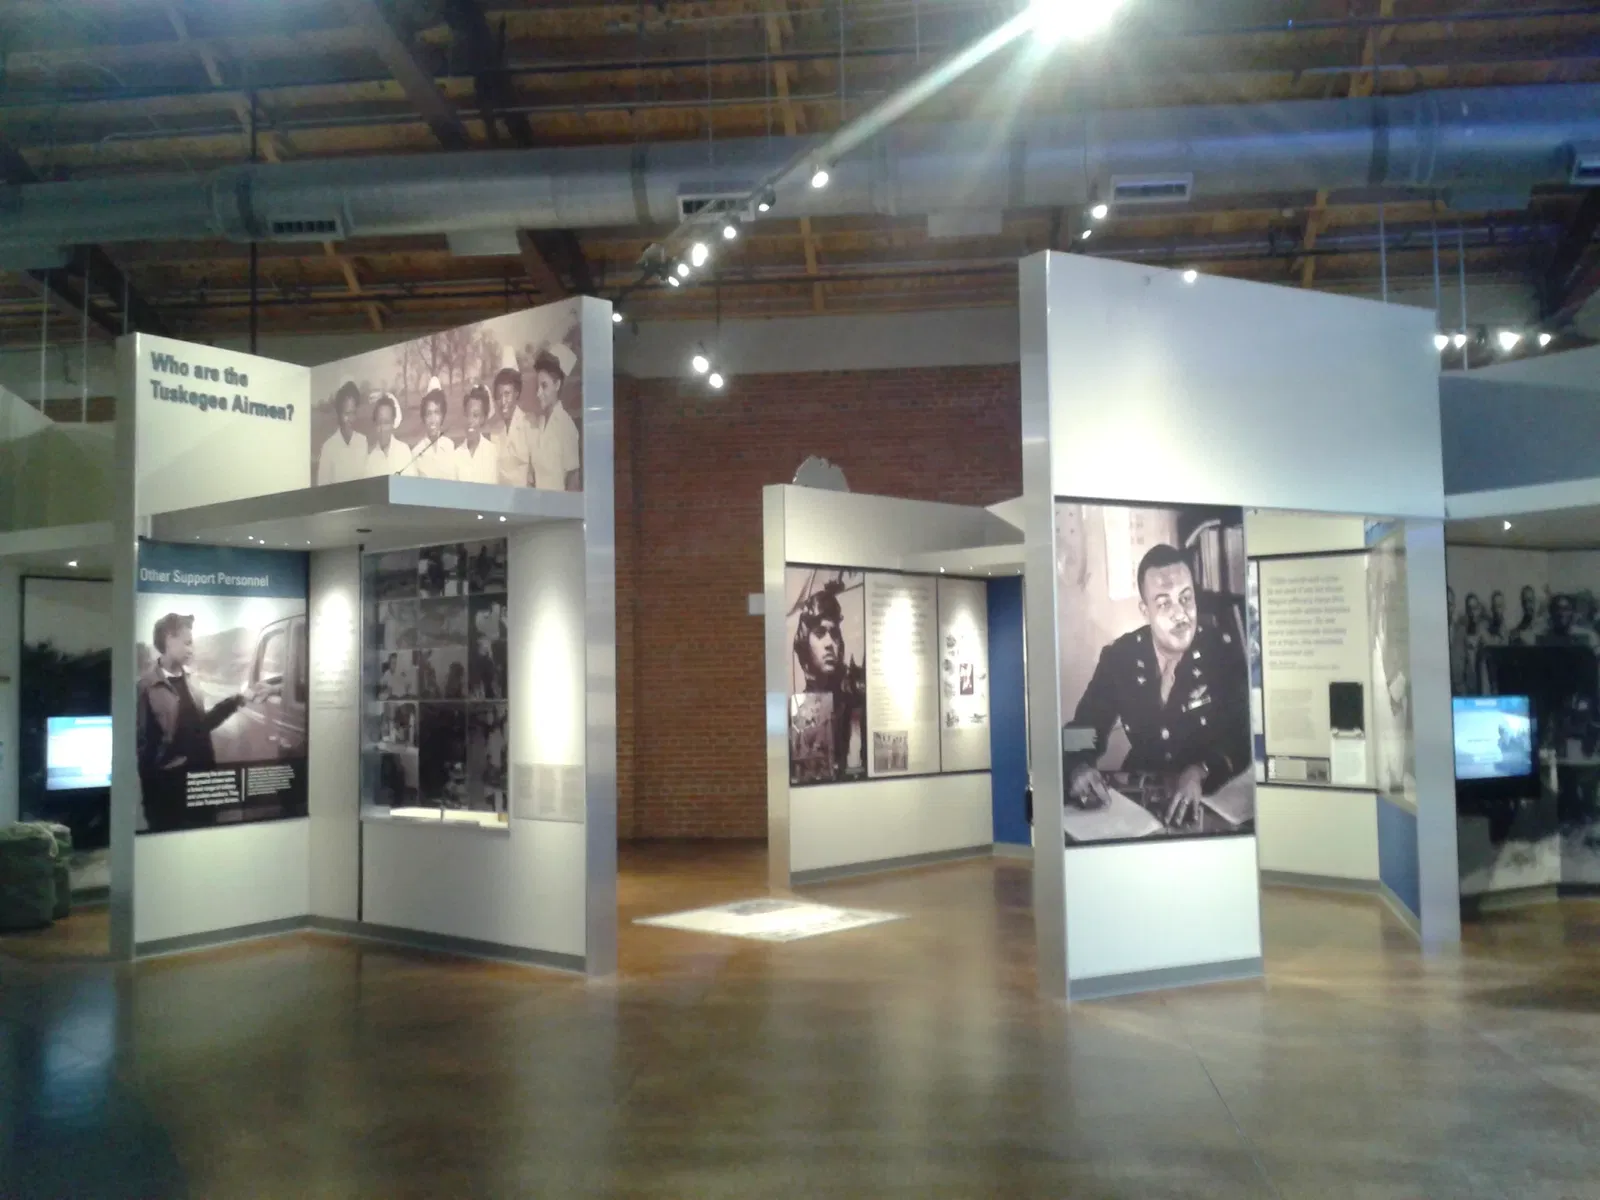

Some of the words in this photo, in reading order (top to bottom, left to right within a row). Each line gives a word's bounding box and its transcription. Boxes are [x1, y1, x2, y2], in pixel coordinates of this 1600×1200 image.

[151, 351, 189, 376] Who
[194, 364, 219, 382] are
[224, 367, 248, 387] the
[150, 379, 228, 412] Tuskegee
[232, 394, 294, 421] Airmen?
[140, 568, 171, 582] Other
[173, 569, 216, 587] Support
[218, 572, 269, 587] Personnel
